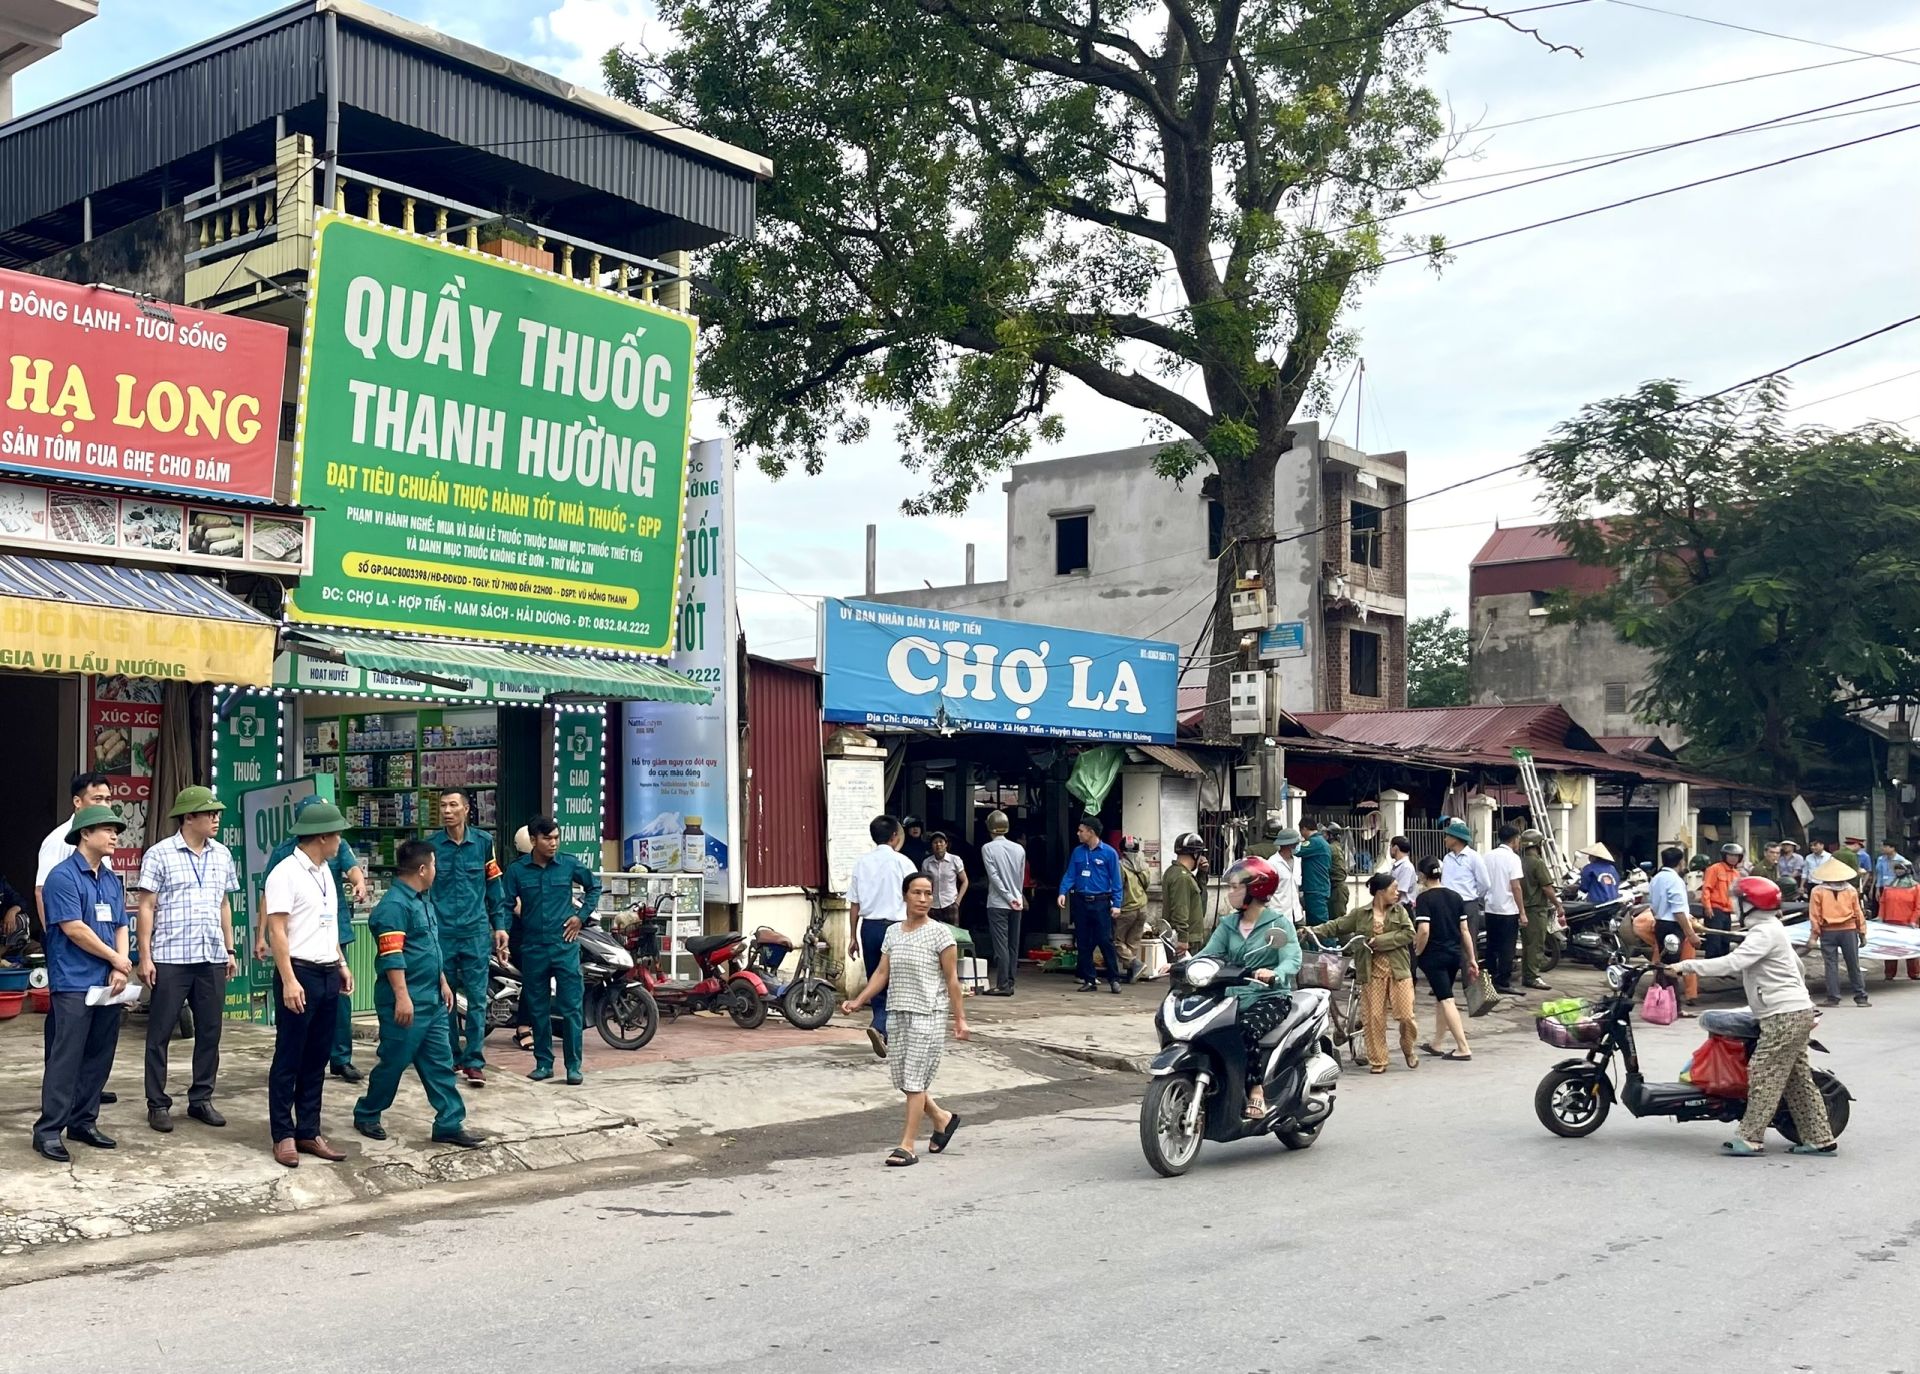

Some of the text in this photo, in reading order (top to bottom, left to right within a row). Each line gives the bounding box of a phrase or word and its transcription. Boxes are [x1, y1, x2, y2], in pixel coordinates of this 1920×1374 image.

[10, 291, 68, 320] ĐÔNG
[73, 305, 120, 333] LẠNH
[136, 316, 174, 342] TƯƠI
[179, 321, 227, 352] SỐNG
[344, 275, 672, 418] QUẦY THUỐC
[7, 355, 262, 444] HẠ LONG
[2, 426, 230, 483] SẢN TÔM CUA GHẸ CHO ĐÁM
[349, 379, 658, 498] THANH HƯỜNG
[326, 462, 358, 494] ĐẠT
[362, 466, 394, 496] TIÊU
[398, 470, 450, 504] CHUẨN
[453, 483, 488, 514] THỰC
[492, 487, 528, 518] HÀNH
[532, 492, 556, 521] TỐT
[558, 501, 584, 527] NHÀ
[588, 504, 627, 534] THUỐC
[638, 515, 662, 539] GPP
[347, 506, 372, 525] PHẠM
[375, 510, 384, 525] VI
[385, 510, 408, 528] HÀNH
[437, 520, 454, 536] MUA
[468, 524, 485, 540] BÁN
[498, 528, 522, 545] THUỐC
[548, 537, 568, 552] DANH
[570, 540, 586, 556] MỤC
[587, 541, 609, 558] THUỐC
[611, 544, 629, 561] THIẾT
[630, 547, 643, 563] YẾU
[419, 538, 442, 554] DANH
[443, 542, 462, 558] MỤC
[464, 543, 489, 560] THUỐC
[581, 561, 594, 575] XIN
[687, 510, 719, 578] TỐT
[358, 560, 369, 573] SỐ
[501, 580, 518, 591] 7H00
[534, 584, 553, 595] 22H00
[608, 594, 627, 604] THANH
[322, 586, 344, 601] ĐC:
[347, 590, 374, 608] CHỢ
[376, 593, 389, 606] LA
[398, 595, 422, 612] HỢP
[425, 595, 446, 612] TIẾN
[454, 601, 478, 616] NAM
[481, 602, 509, 620] SÁCH
[516, 605, 533, 622] HẢI
[536, 610, 571, 626] DƯƠNG
[578, 615, 592, 628] ĐT:
[593, 617, 650, 635] 0832.84.2222
[878, 612, 904, 626] NHÂN
[943, 620, 960, 634] HỢP
[963, 622, 982, 635] TIẾN
[0, 648, 186, 677] GIA VỊ LẨU NƯỚNG
[886, 636, 1146, 720] CHỢ LA
[100, 708, 130, 723] XÚC
[233, 756, 260, 782] THUỐC
[570, 770, 589, 786] GIAO
[565, 792, 592, 814] THUỐC
[560, 822, 596, 845] TẬN NHÀ
